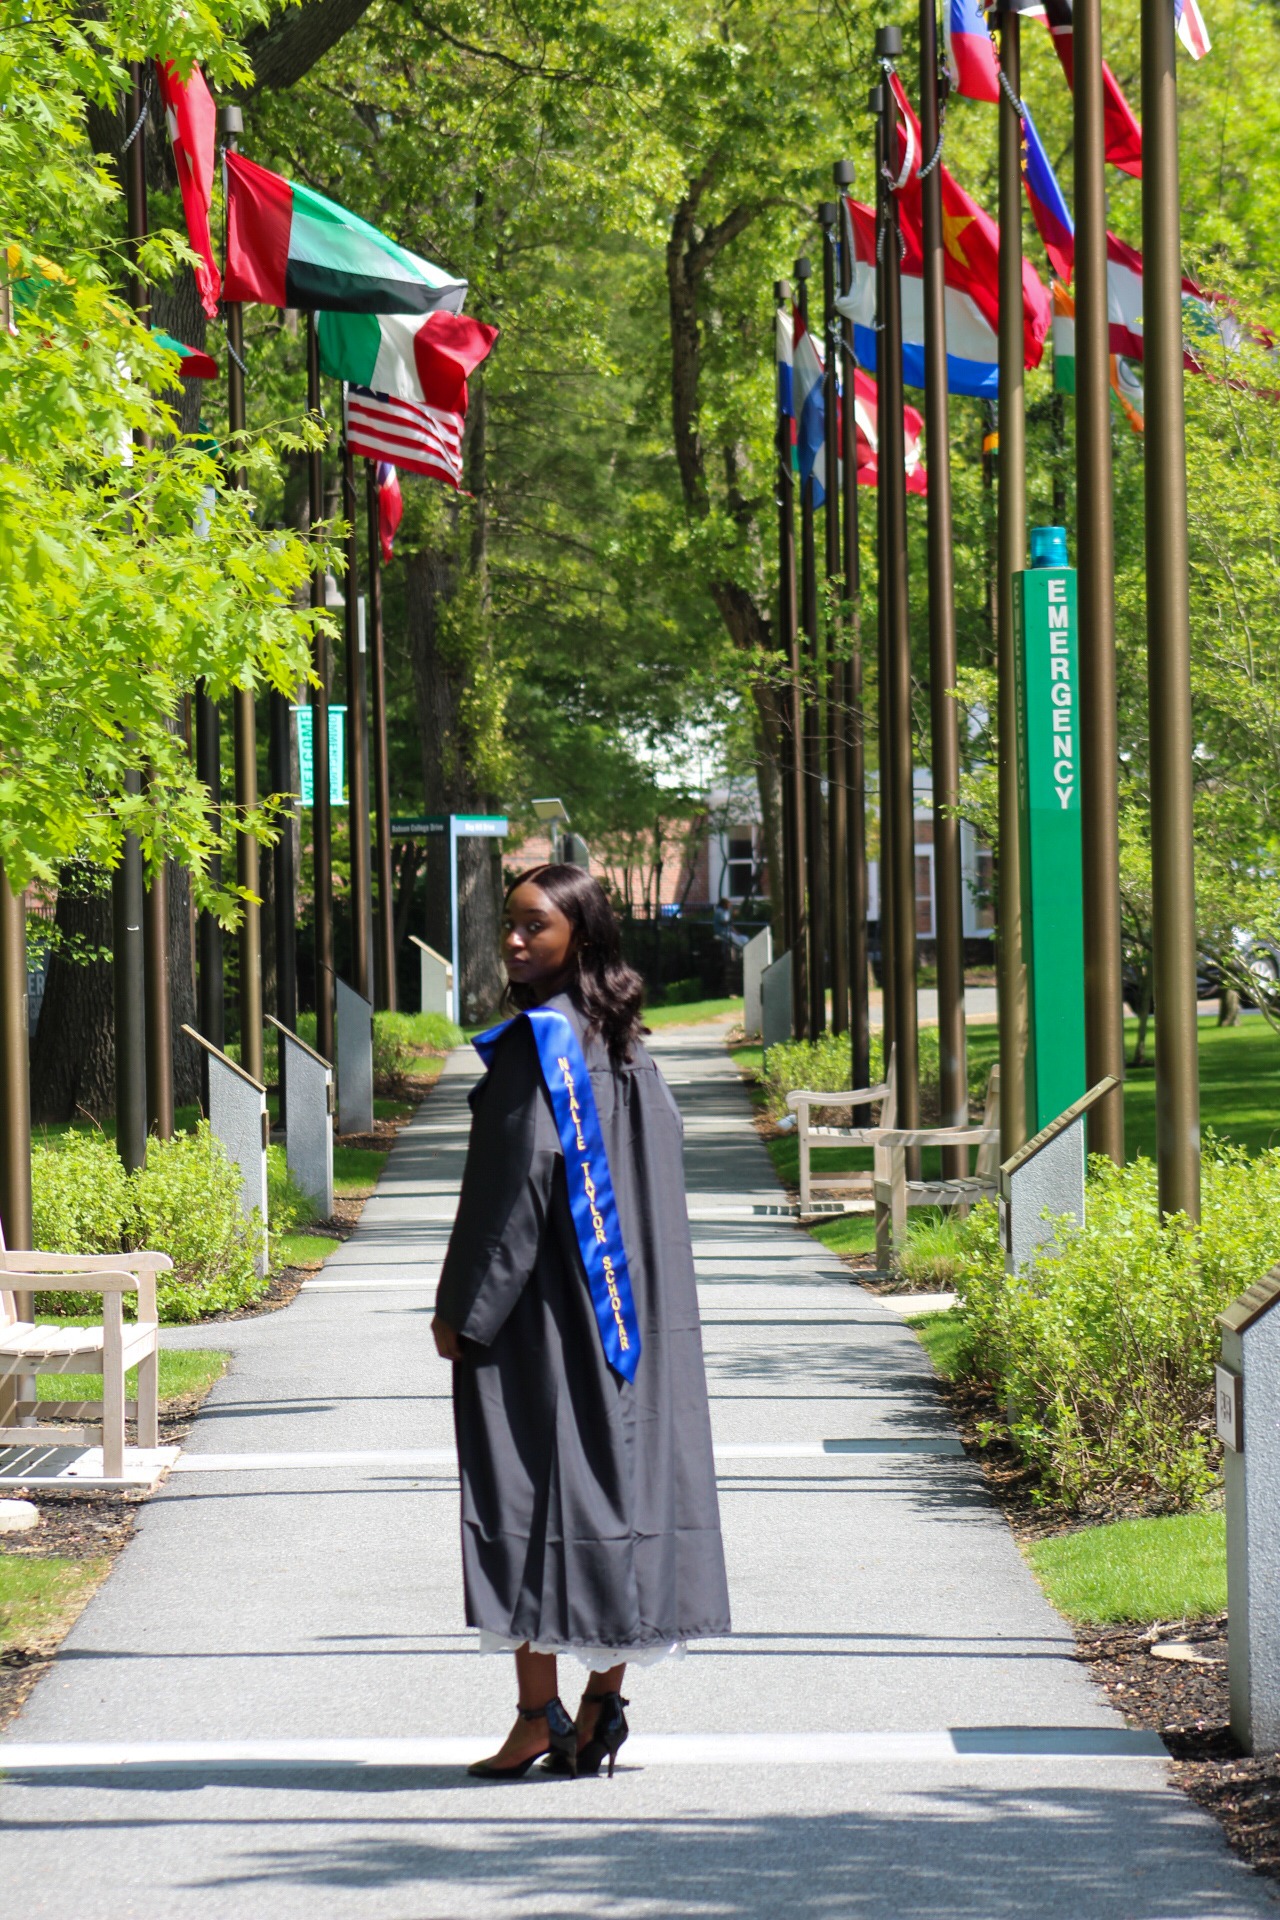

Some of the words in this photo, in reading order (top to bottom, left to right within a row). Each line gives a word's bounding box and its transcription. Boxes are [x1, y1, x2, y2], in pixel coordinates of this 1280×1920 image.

[1047, 579, 1074, 810] EMERGENCY
[410, 823, 429, 834] College
[430, 822, 444, 832] Drive
[557, 1056, 586, 1151] NATALIE
[580, 1162, 607, 1244] TAYLOR
[602, 1255, 630, 1351] SCHOLAR
